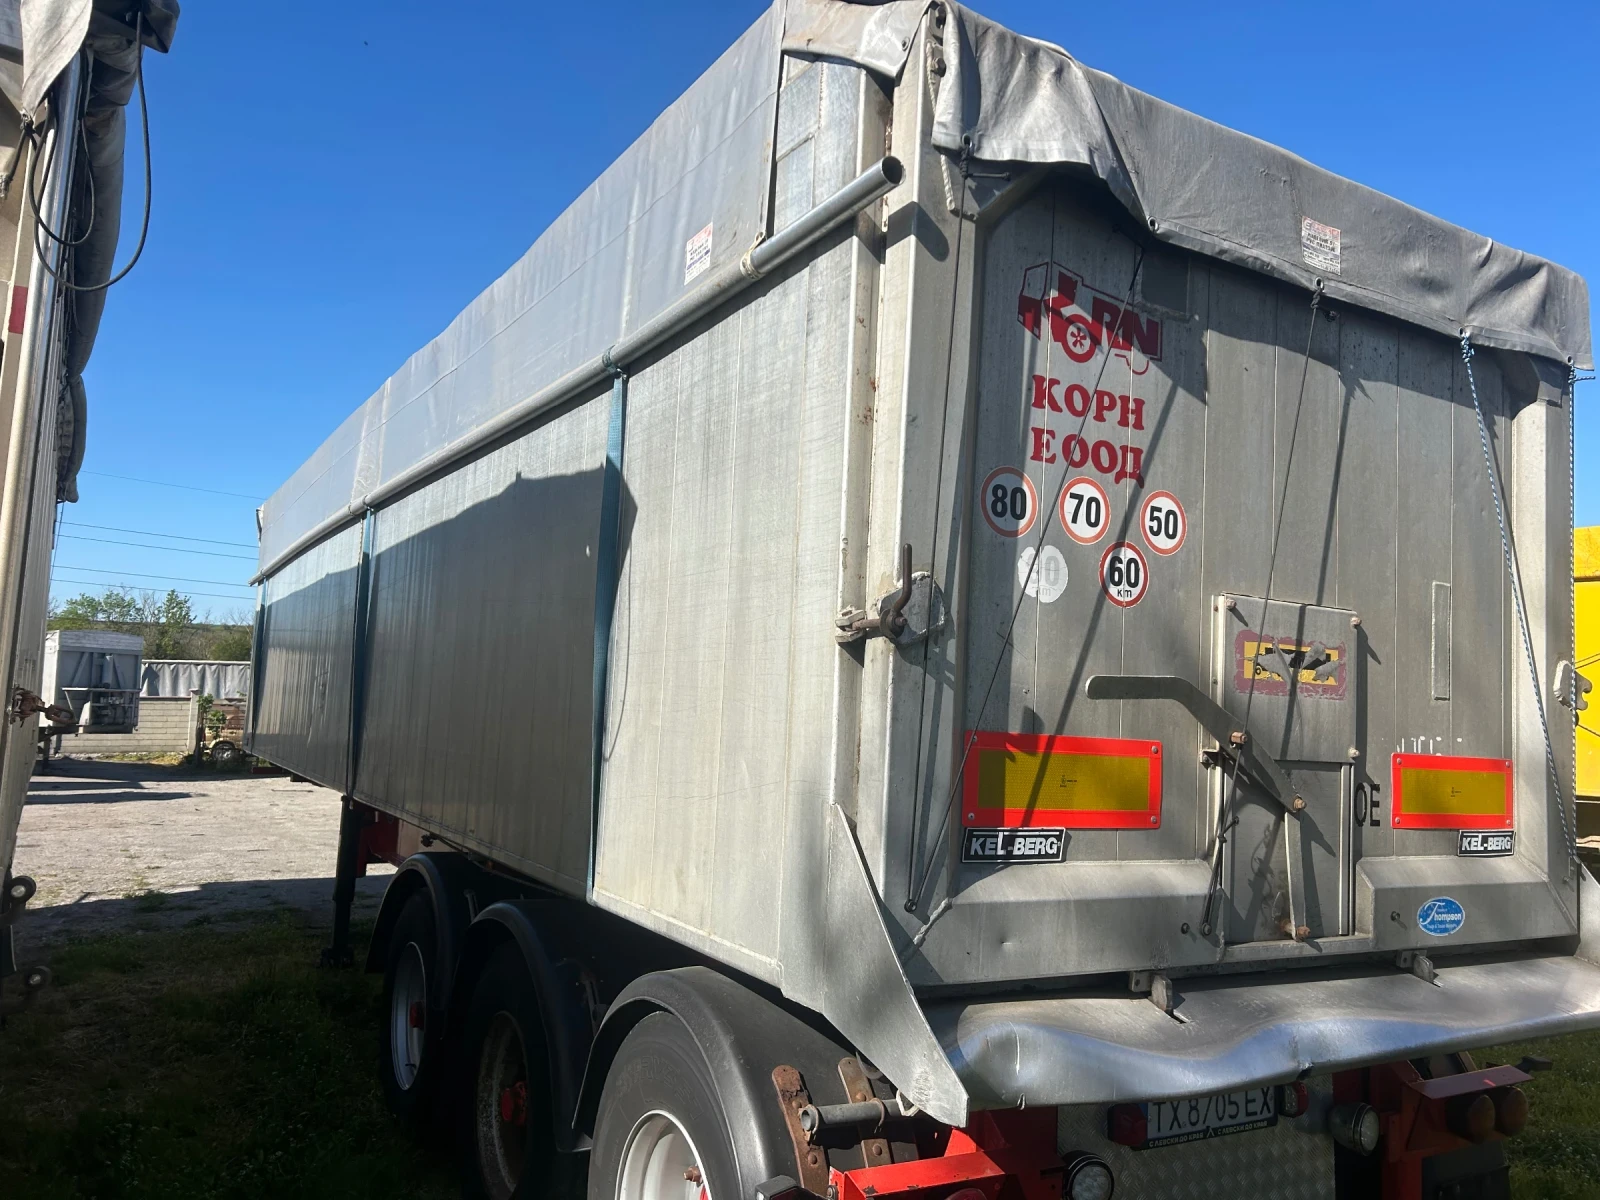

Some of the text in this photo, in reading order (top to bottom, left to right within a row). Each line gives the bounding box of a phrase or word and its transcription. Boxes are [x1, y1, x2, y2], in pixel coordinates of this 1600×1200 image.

[1032, 375, 1146, 430] КОРН
[1030, 427, 1145, 489] ЕООД
[991, 484, 1027, 521] 80
[1069, 492, 1101, 528] 70
[1148, 505, 1179, 540] 50
[1109, 555, 1140, 589] 60
[970, 832, 1058, 856] KEL-BERG
[1462, 833, 1511, 851] KEL-BERG
[1420, 901, 1462, 925] Thompson
